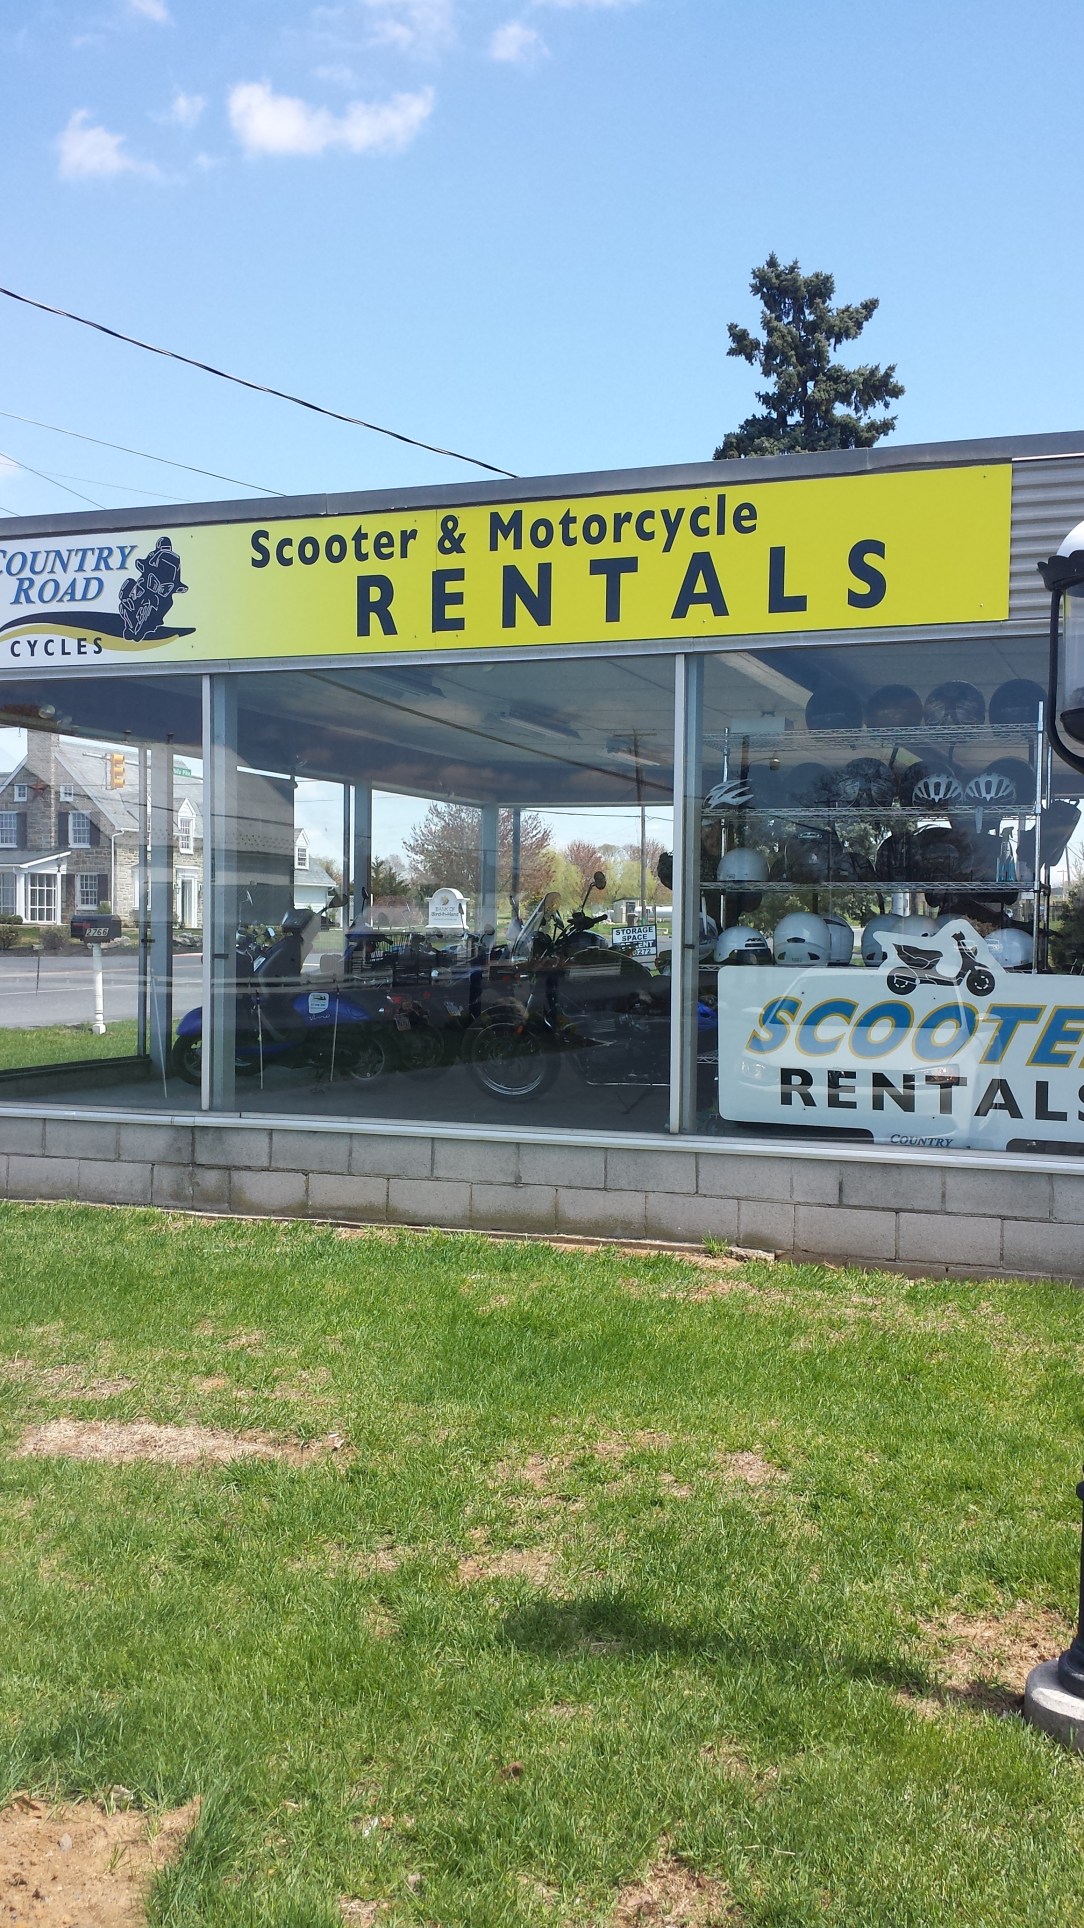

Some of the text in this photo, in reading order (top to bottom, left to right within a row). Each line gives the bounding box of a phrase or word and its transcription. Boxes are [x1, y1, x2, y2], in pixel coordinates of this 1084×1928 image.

[251, 493, 758, 568] Scooter & Motorcycle
[10, 576, 104, 605] ROAD
[356, 539, 887, 637] RENTALS
[10, 637, 103, 658] CYCLES
[86, 928, 108, 936] 2766
[615, 927, 653, 936] STORAGE
[621, 934, 647, 942] SPACE
[634, 940, 654, 948] ENT
[745, 996, 1084, 1069] SCOOTE
[780, 1067, 1084, 1122] RENTAL
[890, 1133, 954, 1148] COUNTRY
